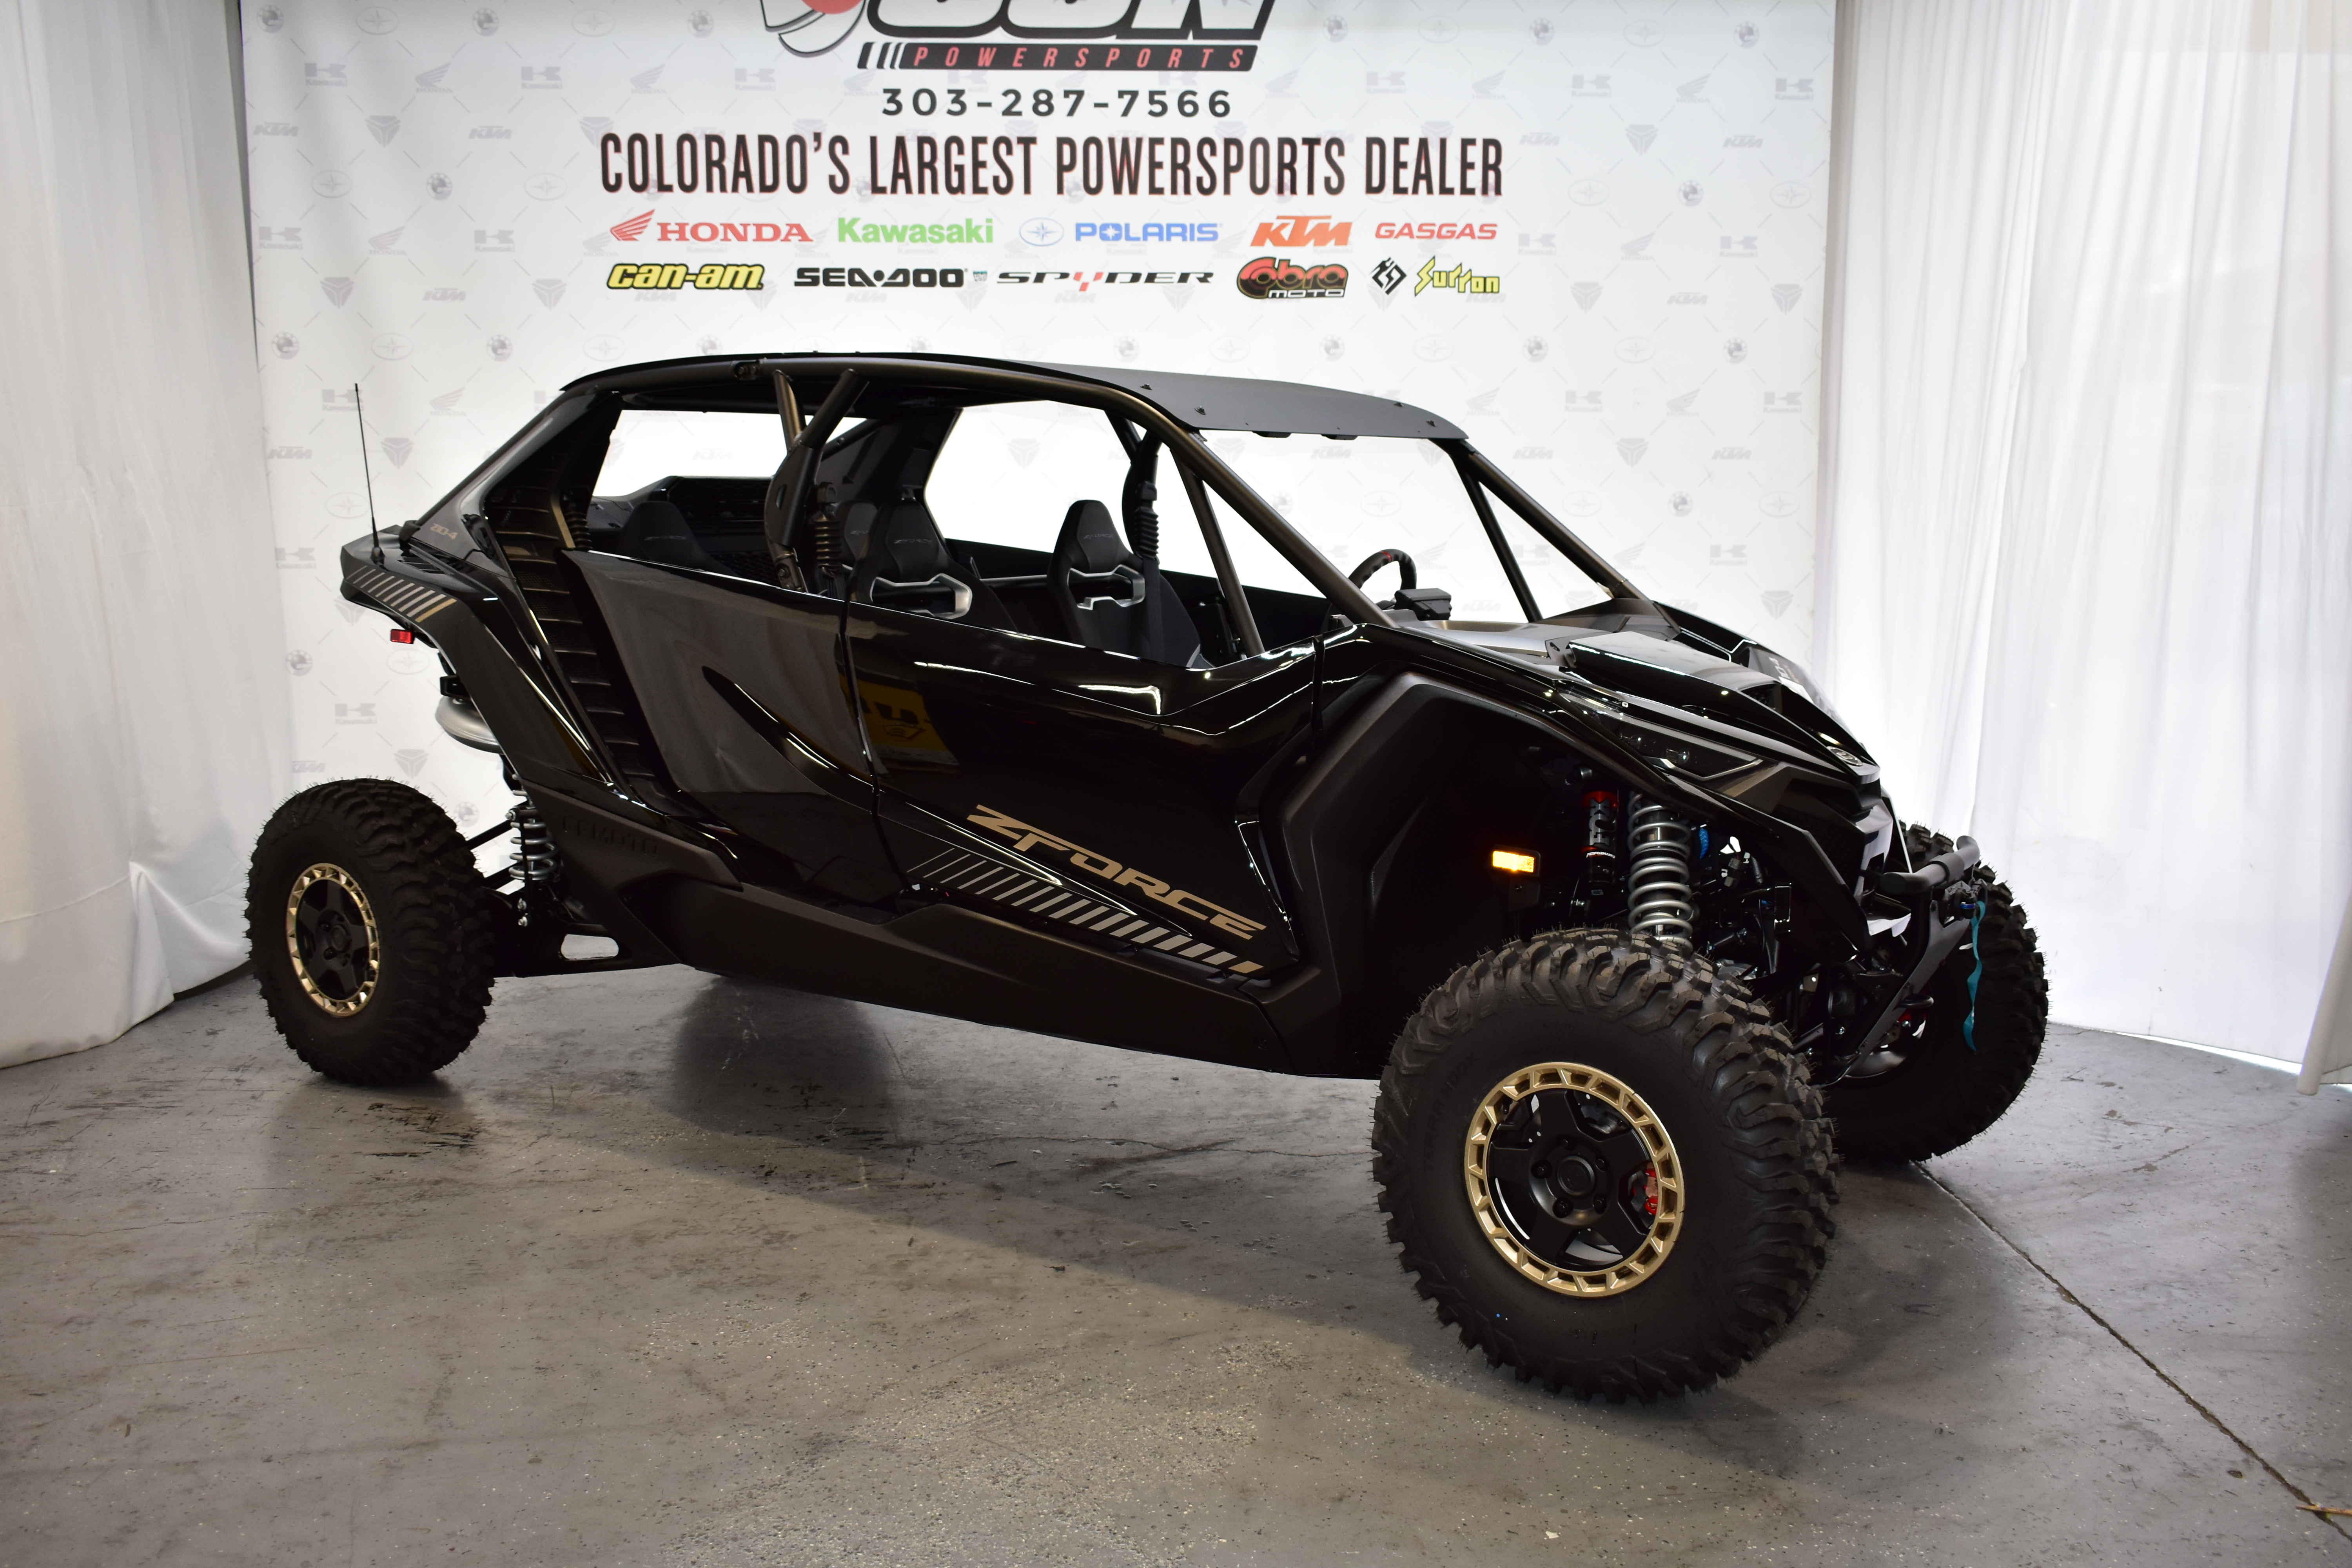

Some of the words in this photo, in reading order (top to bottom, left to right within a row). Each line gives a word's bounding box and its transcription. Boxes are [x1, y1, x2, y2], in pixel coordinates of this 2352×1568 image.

[914, 47, 1243, 67] POWERSPORTS
[882, 88, 1231, 118] 303-287-7566
[252, 123, 299, 136] KTM
[468, 125, 513, 139] KTM
[1519, 132, 1560, 146] KTM
[1722, 134, 1764, 148] KTM
[601, 131, 851, 195] COLORADO'S
[869, 134, 1038, 196] LARGEST
[1056, 135, 1346, 196] POWERSPORTS
[1365, 136, 1503, 197] DEALER
[657, 223, 814, 242] HONDA
[837, 218, 993, 243] Kawasaki
[1075, 223, 1219, 241] POLARIS
[1250, 215, 1352, 247] KTM
[1375, 223, 1498, 240] GASGAS
[606, 263, 766, 290] can-am
[996, 271, 1214, 292] SPYDER
[1236, 257, 1348, 299] Cobra
[422, 287, 467, 301] KTM
[844, 290, 887, 303] KTM
[1053, 290, 1096, 303] KTM
[1268, 289, 1345, 298] MOTO
[1666, 292, 1708, 305] KTM
[268, 447, 312, 459] KTM
[692, 448, 732, 460] KTM
[1311, 446, 1352, 459] KTM
[1512, 446, 1554, 459] KTM
[1711, 447, 1752, 460] KTM
[1462, 599, 1501, 612] KTM
[1588, 798, 1616, 846] FOX
[967, 804, 1267, 940] ZFORCE
